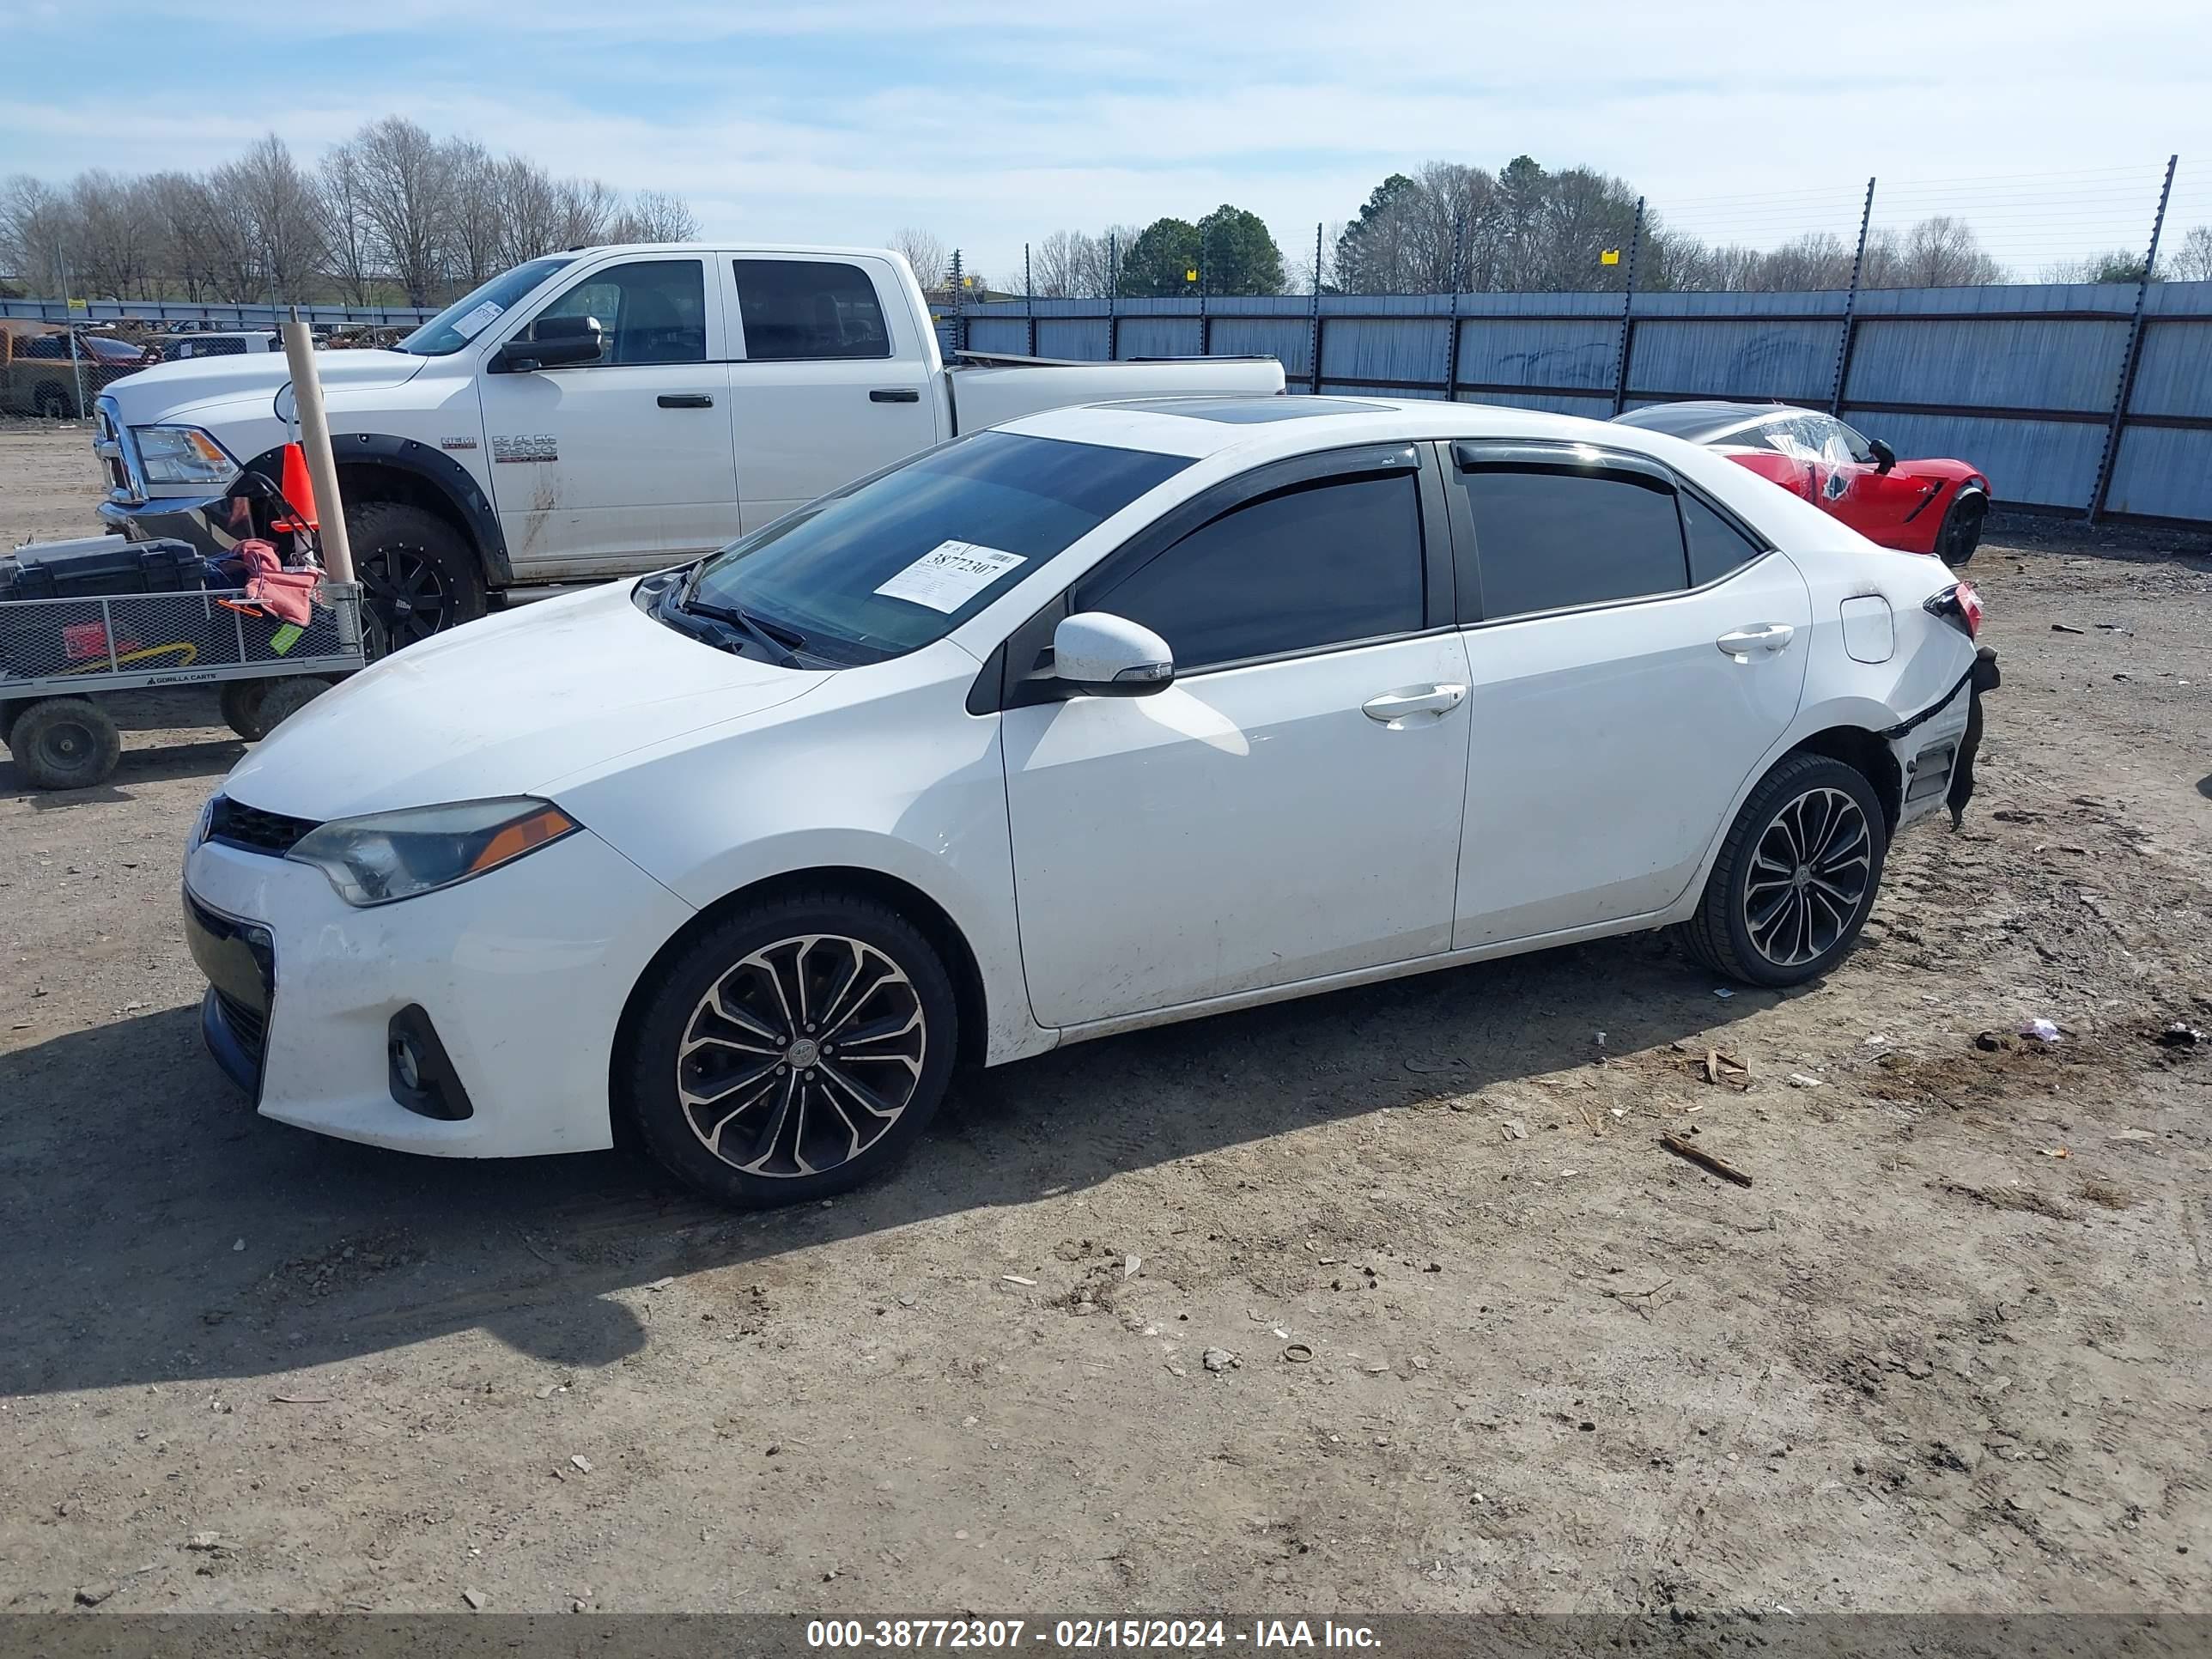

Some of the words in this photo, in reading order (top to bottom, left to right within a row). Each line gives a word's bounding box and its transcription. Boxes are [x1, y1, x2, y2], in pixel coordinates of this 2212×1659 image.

[492, 434, 556, 446] RAM
[494, 446, 556, 456] 2500
[927, 553, 1000, 576] 38772307
[156, 675, 189, 684] GORILLA
